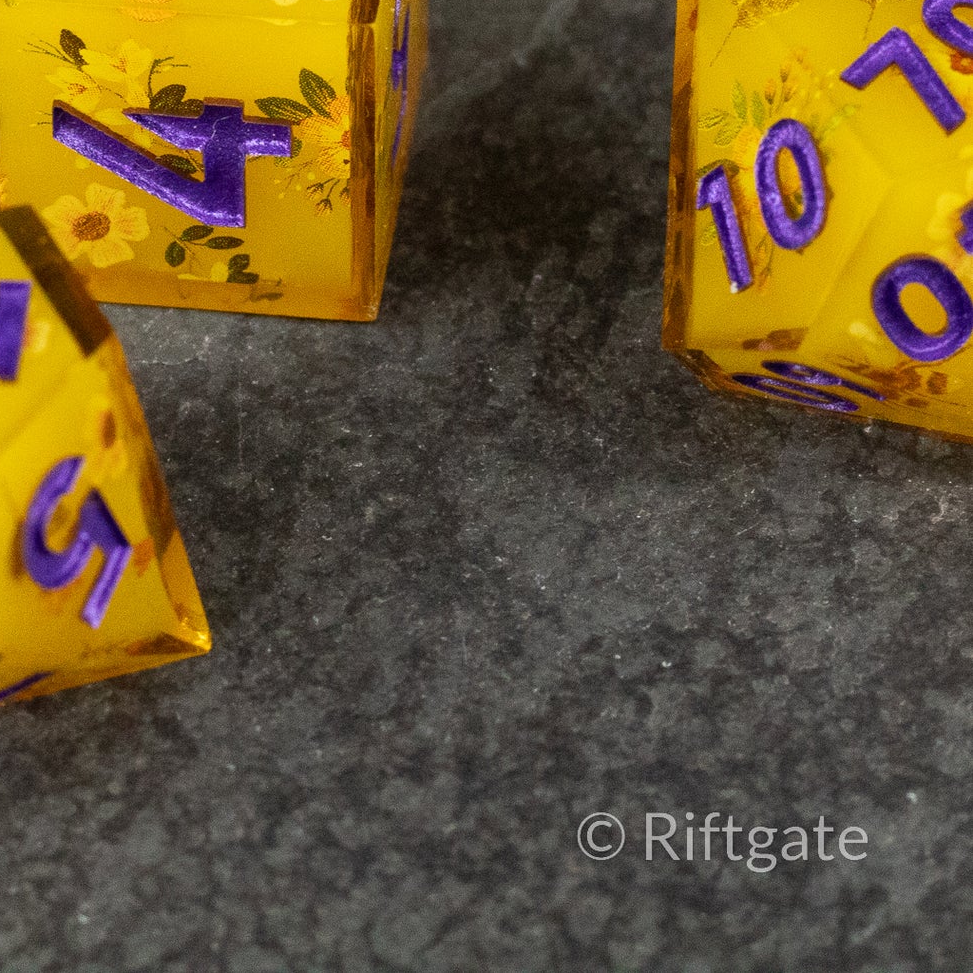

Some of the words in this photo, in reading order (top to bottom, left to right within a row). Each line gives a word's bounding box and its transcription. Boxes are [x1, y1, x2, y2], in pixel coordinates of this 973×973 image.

[52, 98, 293, 227] 4
[696, 118, 827, 292] 10
[25, 456, 133, 628] 5
